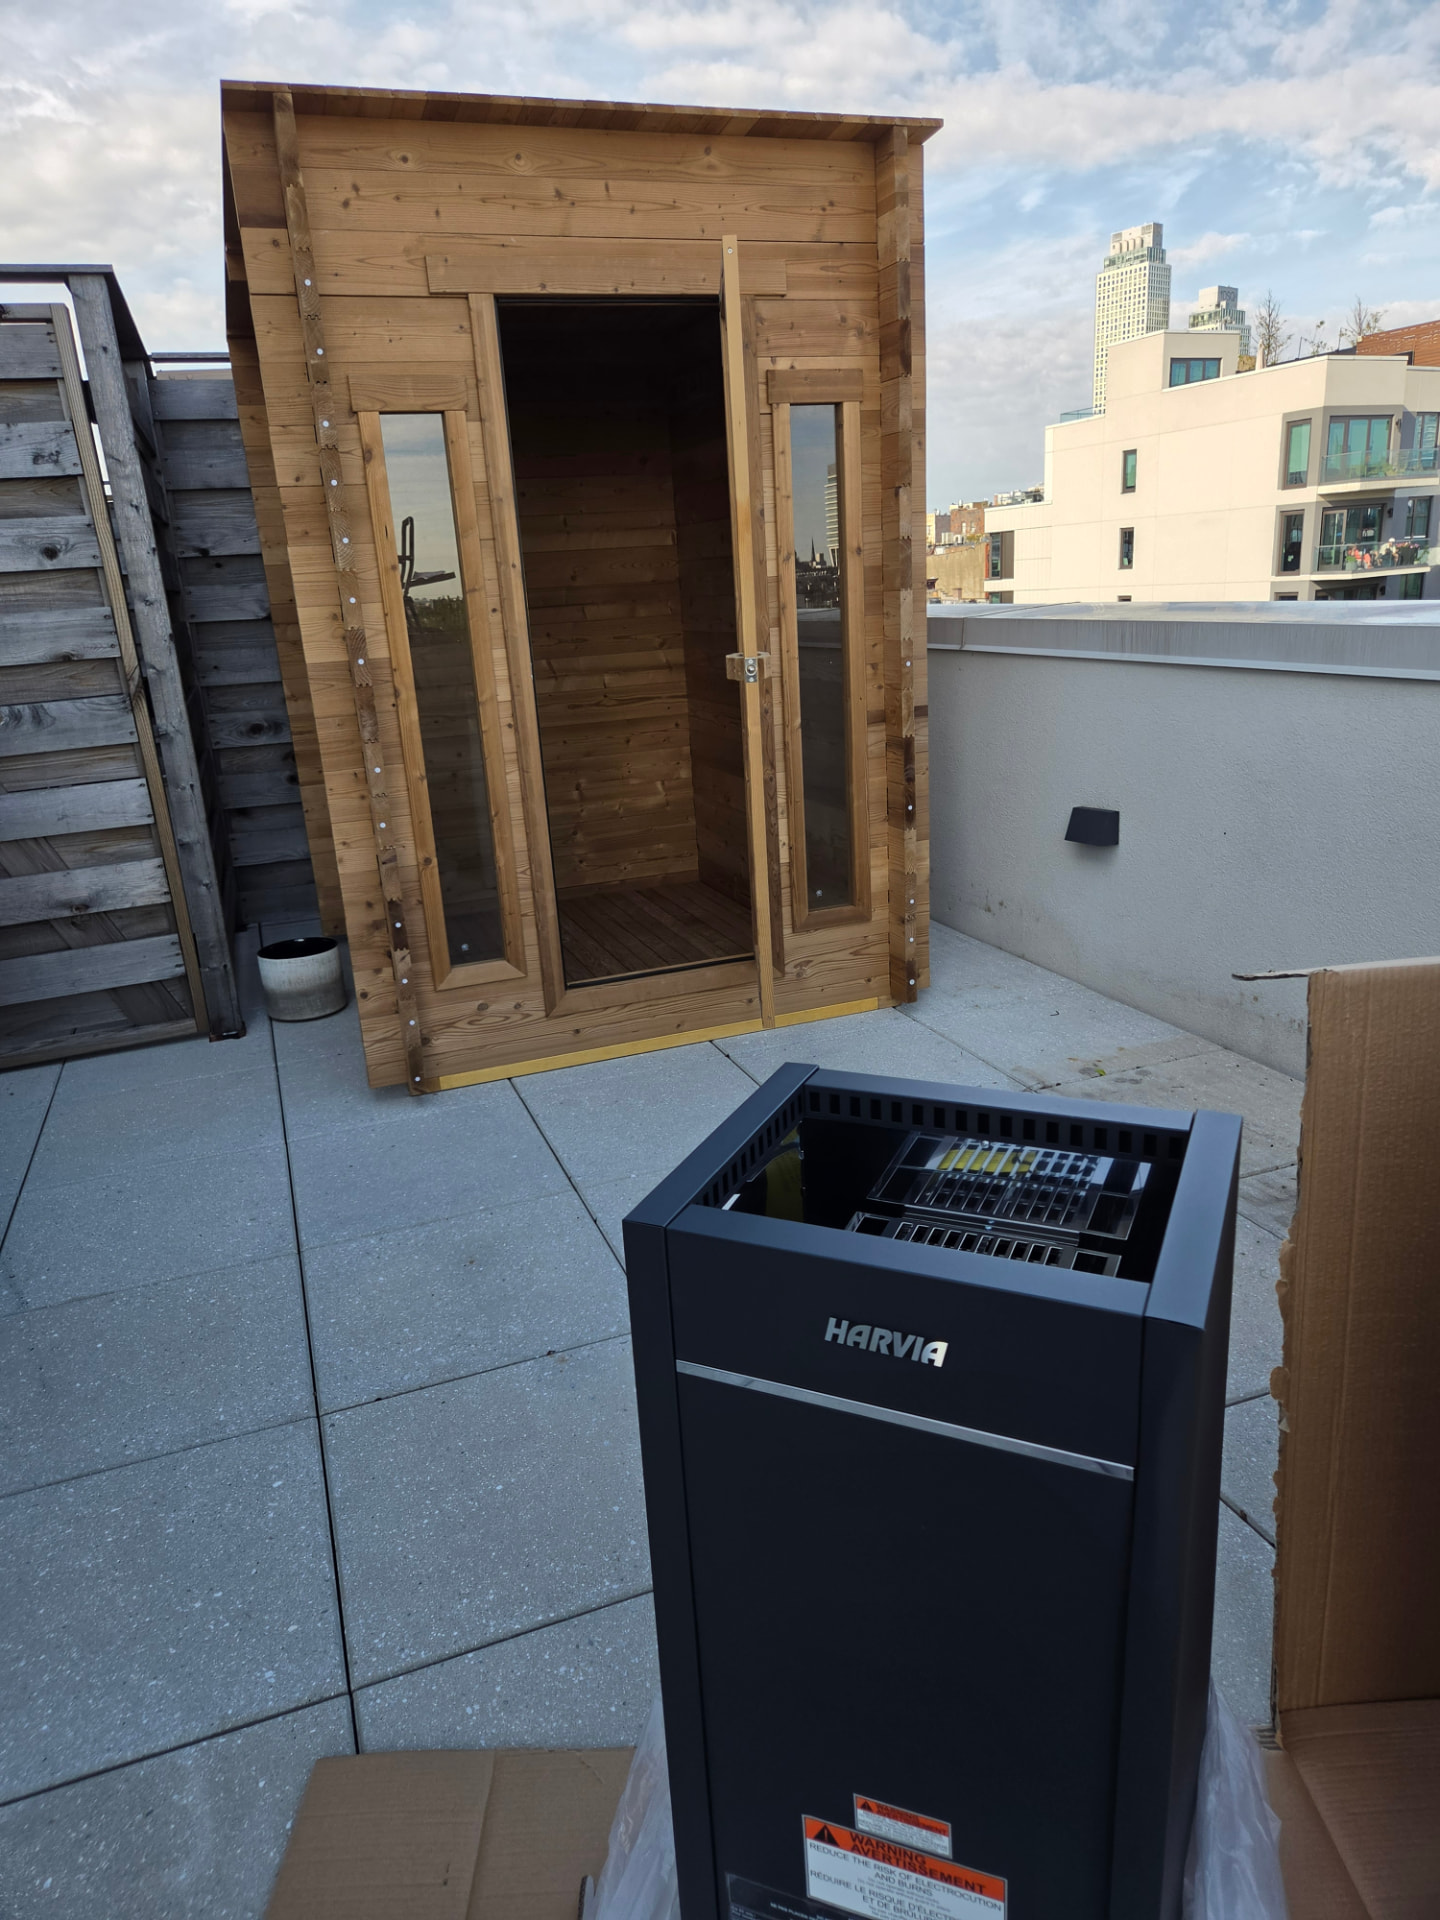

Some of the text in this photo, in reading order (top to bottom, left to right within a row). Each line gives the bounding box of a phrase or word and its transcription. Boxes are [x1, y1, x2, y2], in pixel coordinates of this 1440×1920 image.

[824, 1317, 949, 1368] HARVIA
[849, 1831, 926, 1864] WARNING
[809, 1842, 849, 1861] REDUCE
[852, 1855, 871, 1867] THE
[873, 1863, 896, 1877] RISK
[898, 1872, 912, 1880] OF
[915, 1877, 1002, 1911] ELECTROCUTION
[850, 1843, 987, 1894] AVERTISSEMENT
[874, 1871, 896, 1884] AND
[898, 1879, 934, 1897] BURNS
[854, 1884, 866, 1894] LE
[868, 1889, 905, 1906] RISQUE
[862, 1894, 874, 1904] ET
[877, 1899, 890, 1909] DE
